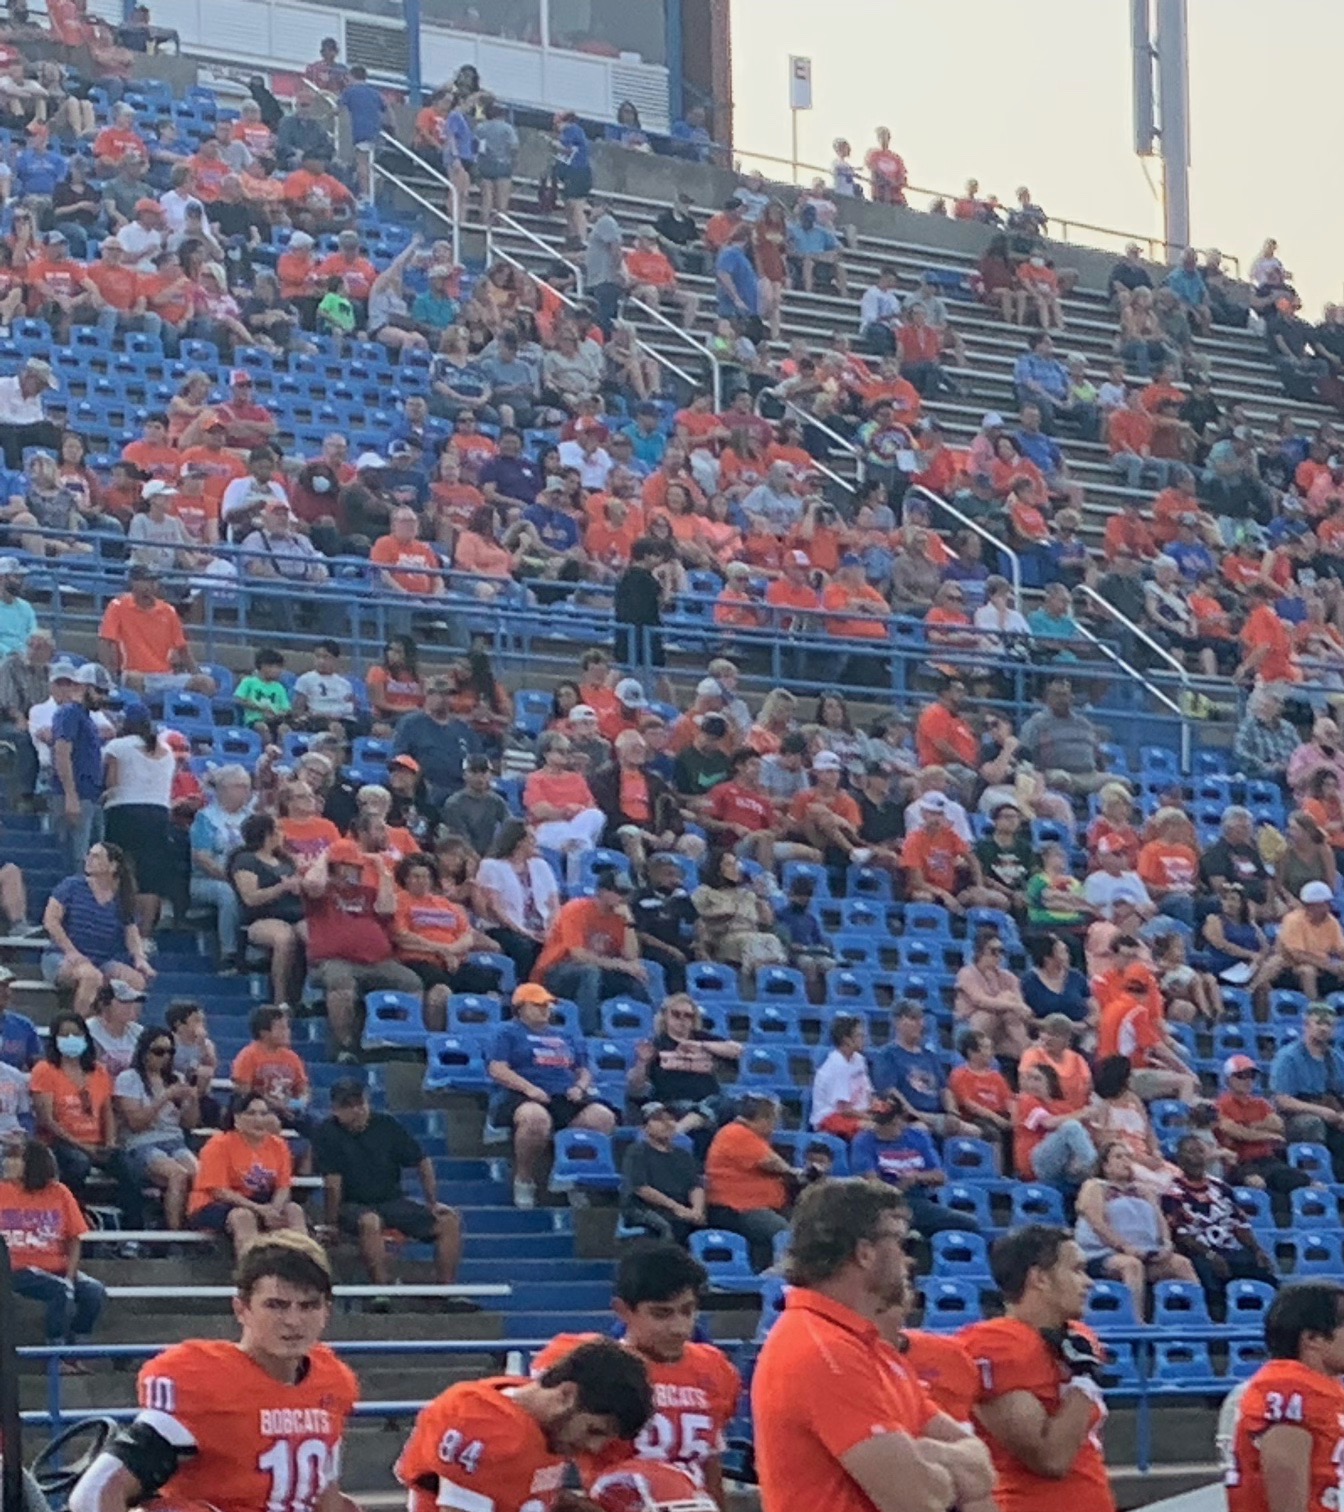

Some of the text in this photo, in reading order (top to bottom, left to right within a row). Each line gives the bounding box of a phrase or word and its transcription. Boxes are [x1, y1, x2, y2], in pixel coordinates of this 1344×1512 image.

[260, 1408, 332, 1434] BOBCATS
[1264, 1391, 1303, 1421] 34
[438, 1428, 484, 1475] 84
